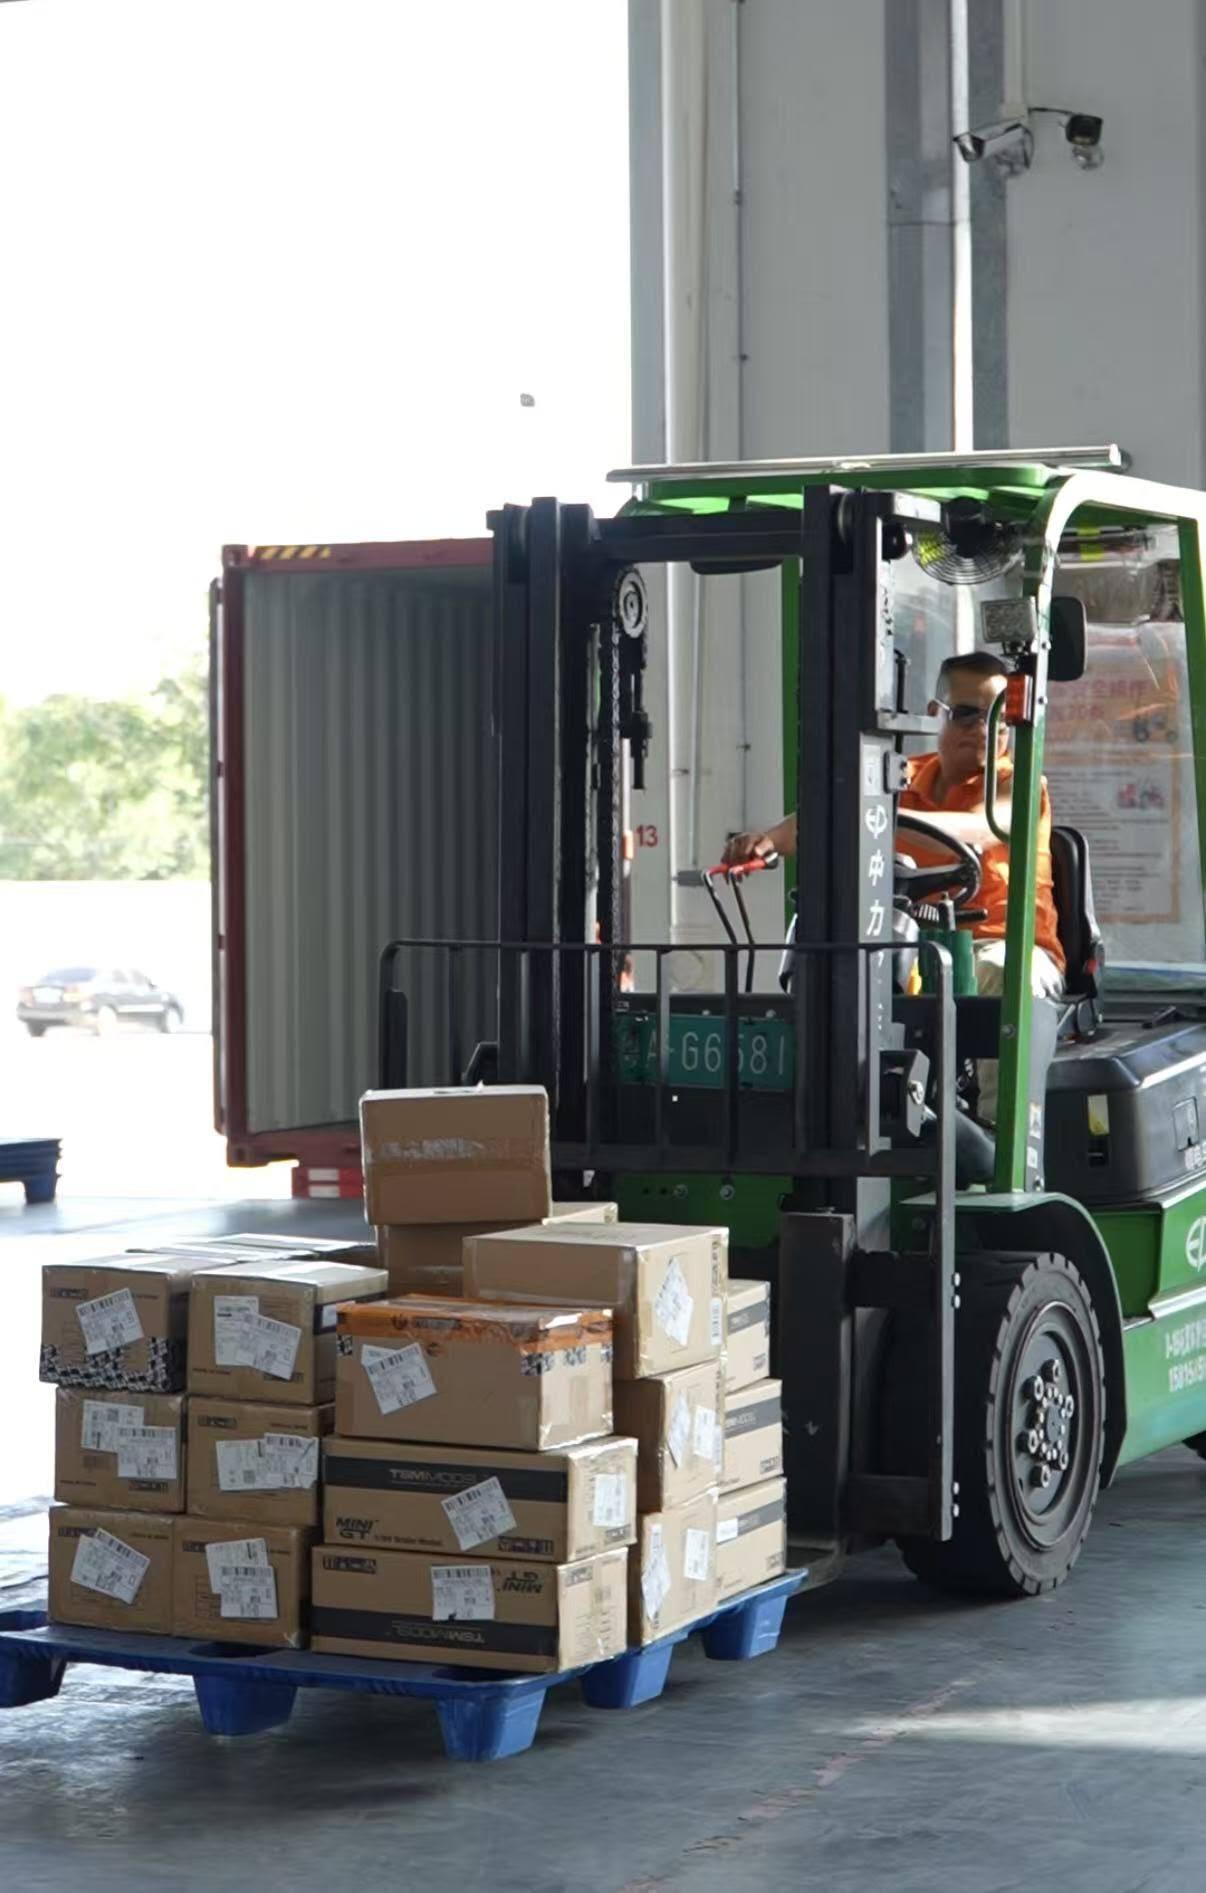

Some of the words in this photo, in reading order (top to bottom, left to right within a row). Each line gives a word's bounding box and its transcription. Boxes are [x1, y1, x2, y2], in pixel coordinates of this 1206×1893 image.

[636, 824, 659, 848] 13
[336, 1517, 374, 1530] MINI
[339, 1529, 369, 1540] GT
[503, 1580, 543, 1594] MINI
